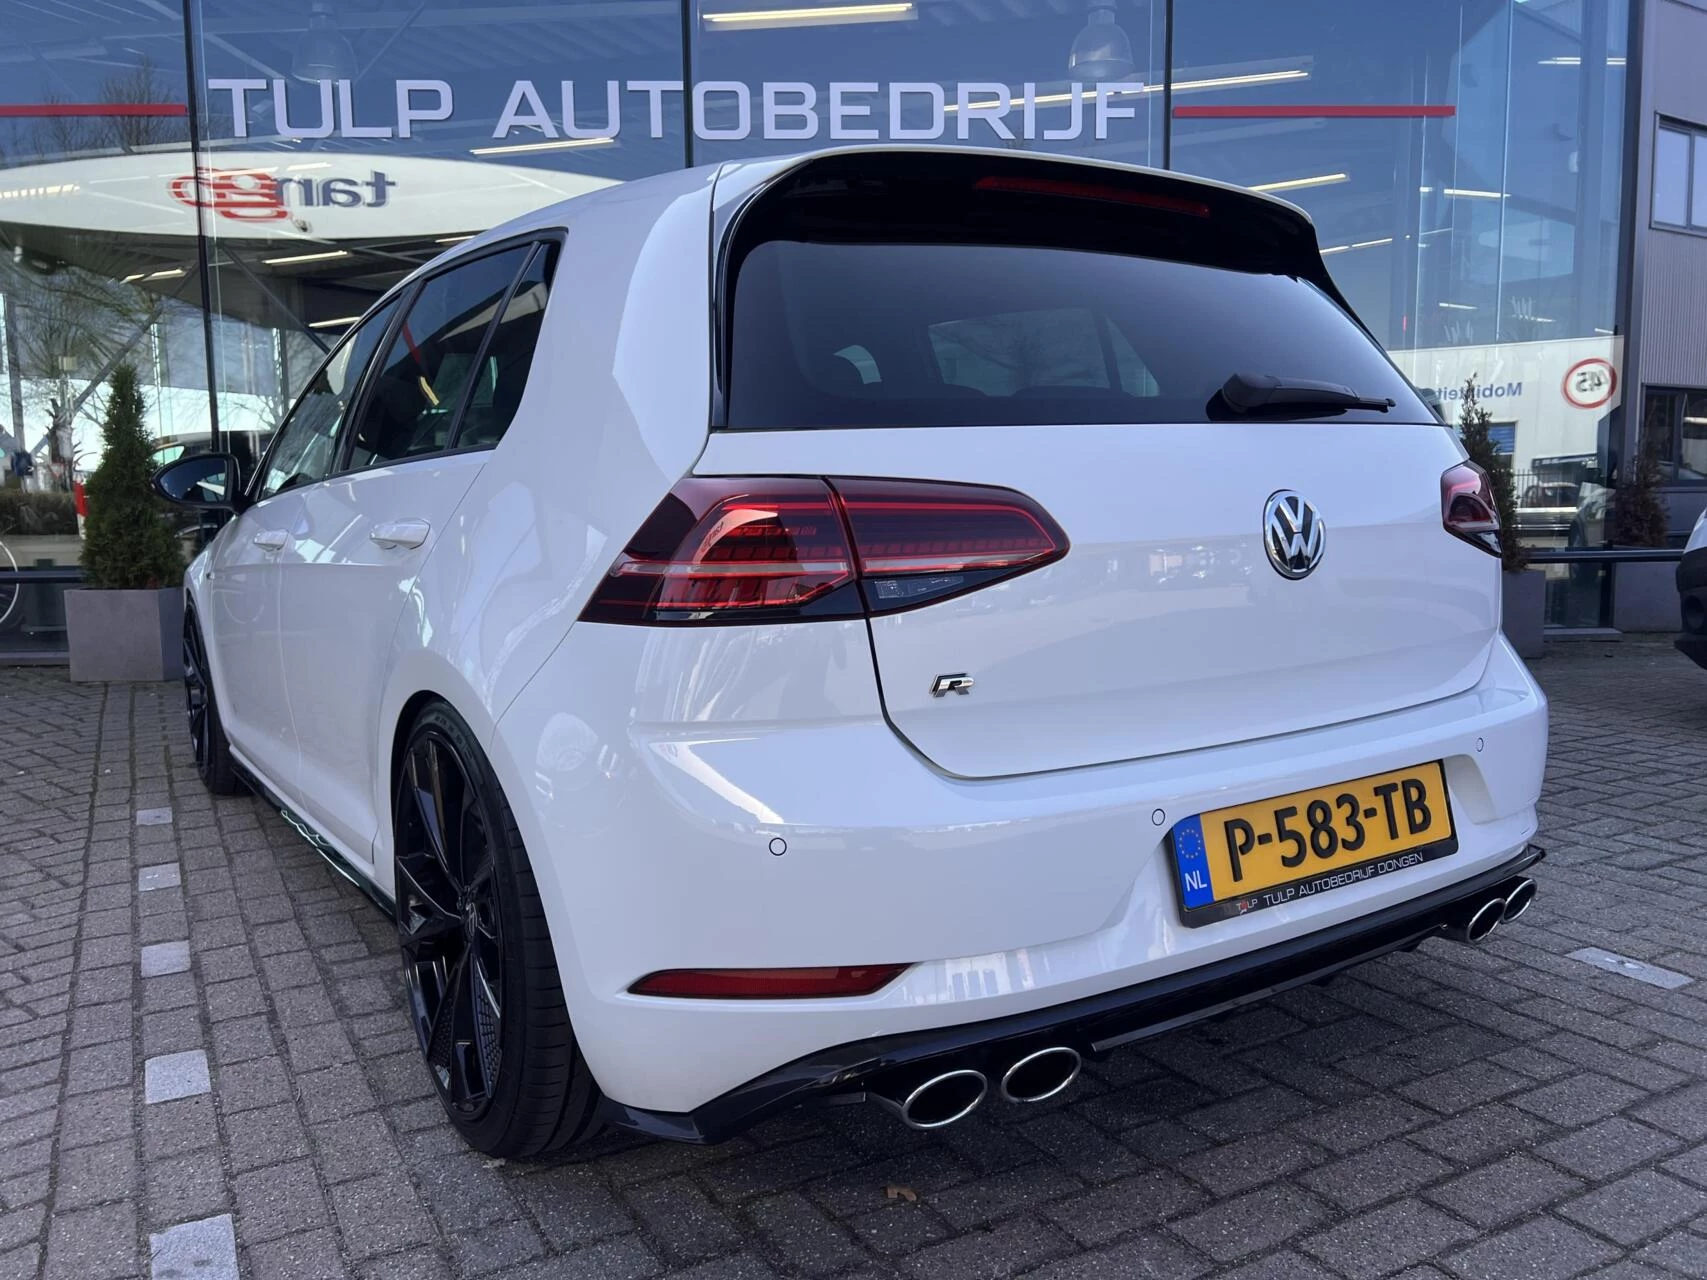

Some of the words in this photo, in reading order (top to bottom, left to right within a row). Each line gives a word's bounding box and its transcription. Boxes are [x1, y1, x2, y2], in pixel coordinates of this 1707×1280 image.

[207, 78, 454, 139] TULP
[492, 79, 1145, 141] AUTOBEDRIJF
[1223, 778, 1432, 882] P-583-TB
[1184, 871, 1208, 892] NL
[1263, 888, 1295, 906] TULP
[1299, 865, 1375, 896] AUTOBEDRIJF
[1378, 852, 1424, 876] DONGEN
